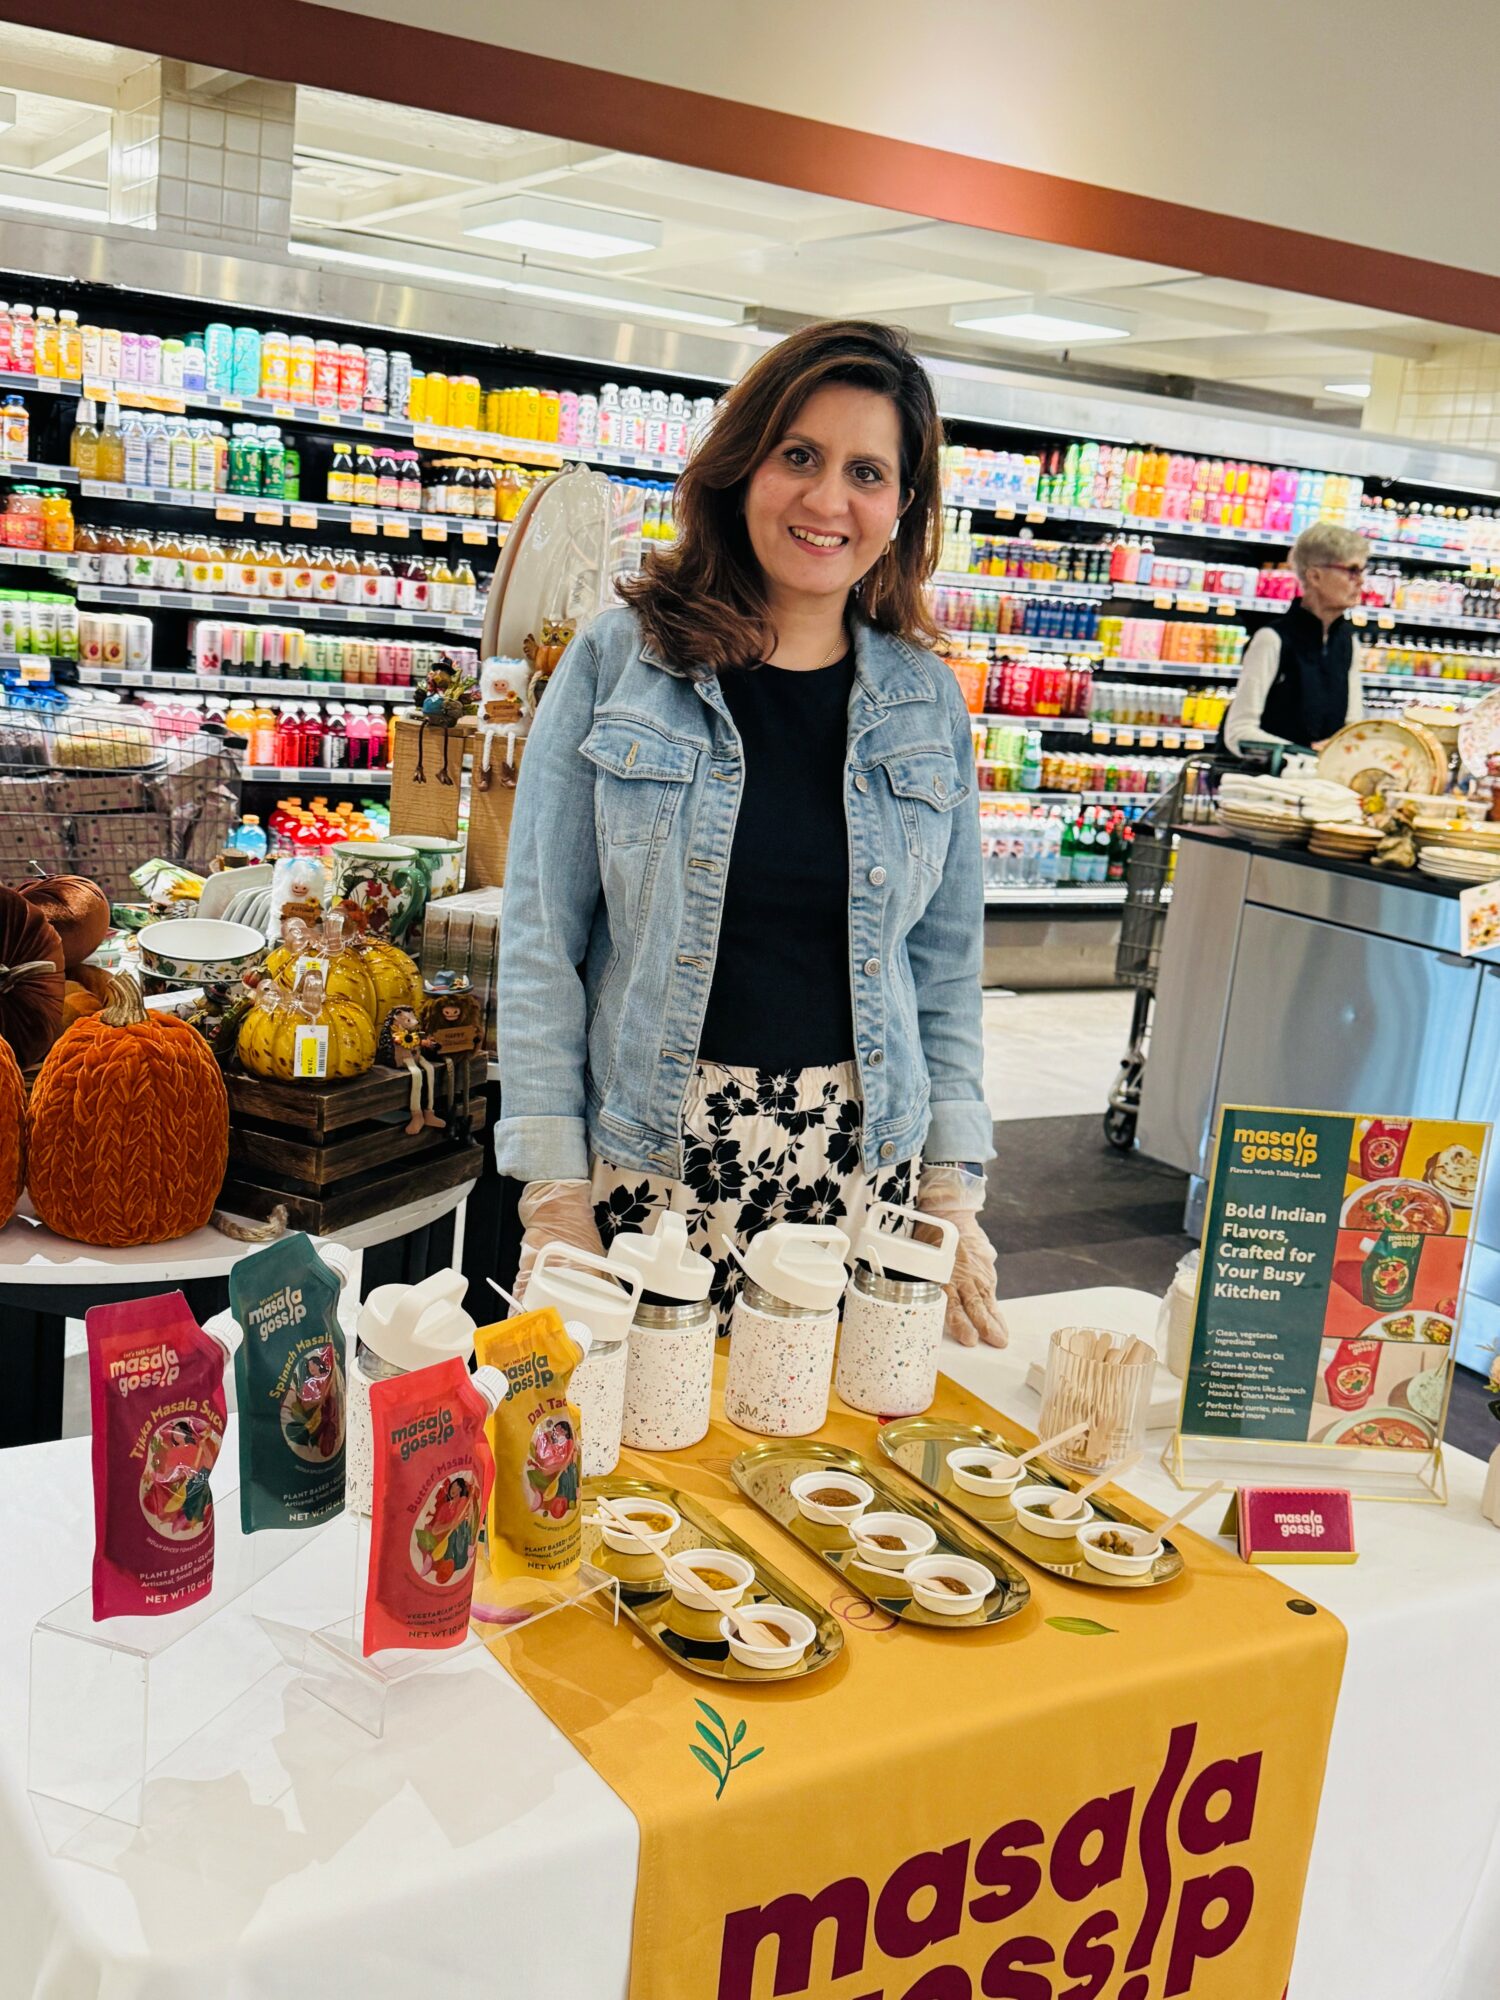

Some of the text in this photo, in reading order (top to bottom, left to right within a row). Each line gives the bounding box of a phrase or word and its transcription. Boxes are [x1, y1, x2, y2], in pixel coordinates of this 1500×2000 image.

[624, 420, 634, 446] hint
[649, 424, 659, 450] hint
[668, 427, 680, 453] hint
[1233, 1126, 1318, 1148] masala
[1241, 1144, 1318, 1168] gossip
[1229, 1166, 1321, 1179] Flavors Worth Talking About
[1225, 1202, 1327, 1224] Bold Indian
[1222, 1222, 1289, 1244] Flavors,
[1219, 1243, 1316, 1263] Crafted for
[1216, 1262, 1306, 1286] Your Busy
[1214, 1283, 1281, 1301] Kitchen
[248, 1286, 303, 1326] masala
[260, 1304, 307, 1342] gossip
[1215, 1337, 1256, 1346] ingredients
[1216, 1329, 1278, 1340] Clean, vegetarian
[109, 1344, 179, 1379] masala
[1213, 1350, 1285, 1361] Made with Olive Oil
[269, 1350, 298, 1399] Spinach
[1211, 1361, 1237, 1370] Gluten
[1258, 1364, 1275, 1374] free,
[1221, 1371, 1269, 1380] preservatives
[118, 1365, 180, 1398] gossip
[1208, 1381, 1306, 1394] Unique flavors like Spinach
[1208, 1390, 1232, 1398] Masala
[1241, 1391, 1264, 1400] Chana
[1265, 1394, 1290, 1402] Masala
[527, 1403, 546, 1426] Dal
[738, 1400, 758, 1417] SM
[1204, 1410, 1266, 1420] pastas, and more
[1206, 1401, 1296, 1415] Perfect for curries, pizzas,
[129, 1420, 152, 1459] Tikka
[150, 1397, 198, 1423] Masala
[391, 1406, 452, 1445] masala
[400, 1424, 455, 1461] gossip
[406, 1473, 436, 1514] Butter
[289, 1512, 309, 1521] NET
[1274, 1509, 1323, 1524] masala
[1280, 1522, 1325, 1538] gossip
[139, 1570, 168, 1580] PLANT
[169, 1561, 194, 1576] BASED
[527, 1561, 547, 1571] NET
[547, 1561, 563, 1571] WT
[562, 1558, 570, 1568] 10
[145, 1594, 168, 1604] NET
[170, 1586, 186, 1600] WT
[187, 1582, 196, 1594] 10
[408, 1631, 429, 1639] NET
[431, 1628, 448, 1638] WT
[715, 1722, 1263, 2000] masala
[852, 1866, 1255, 2000] ssip
